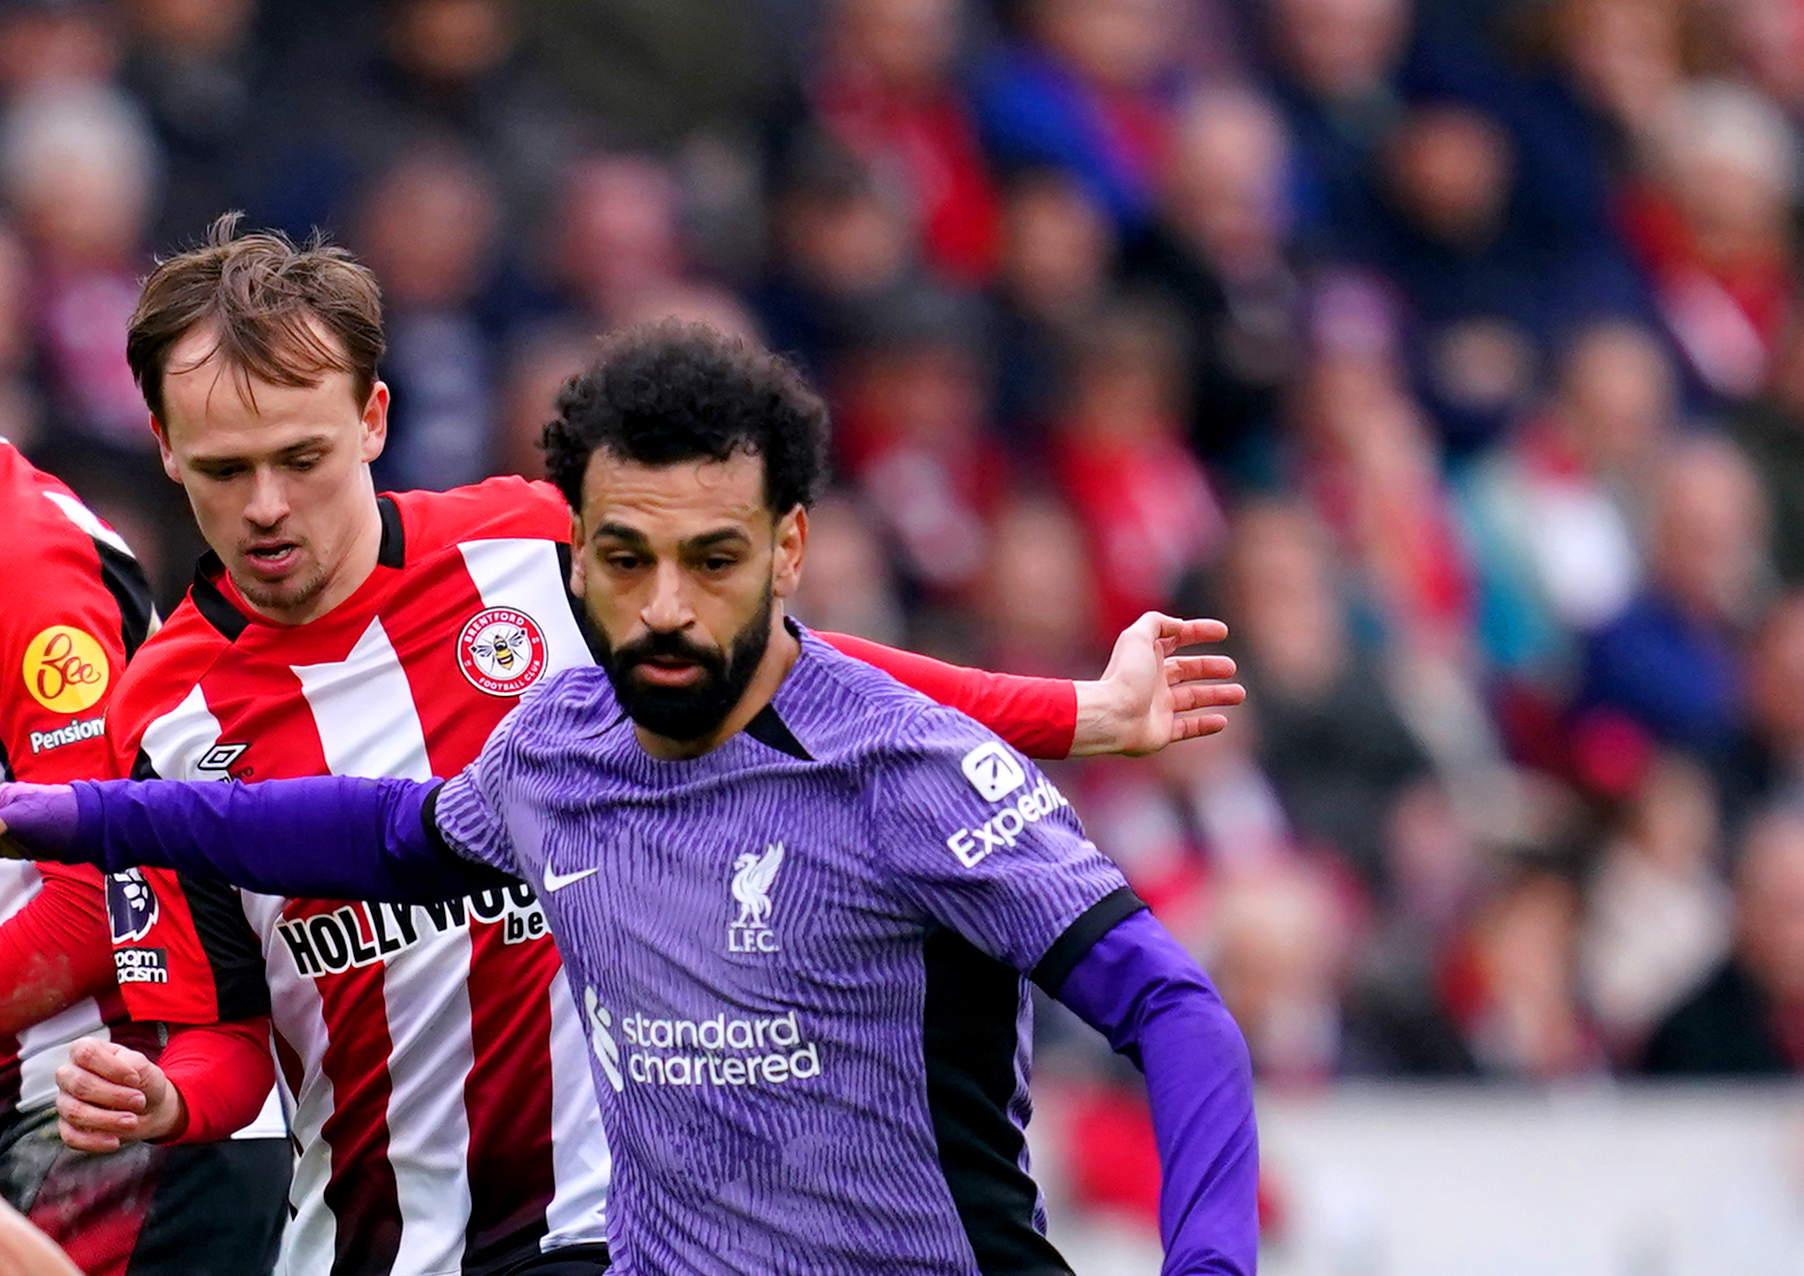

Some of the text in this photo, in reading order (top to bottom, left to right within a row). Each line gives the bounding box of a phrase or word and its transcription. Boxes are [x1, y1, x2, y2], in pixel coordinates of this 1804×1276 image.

[464, 612, 525, 643] BRENTFORD
[479, 660, 541, 691] FOOTBALL CLUB
[29, 715, 105, 754] Pension
[277, 884, 539, 975] HOLLYWO
[507, 911, 544, 941] be
[114, 949, 158, 967] oom
[116, 966, 167, 984] acism
[622, 1009, 801, 1050] standard
[630, 1042, 821, 1086] chartered
